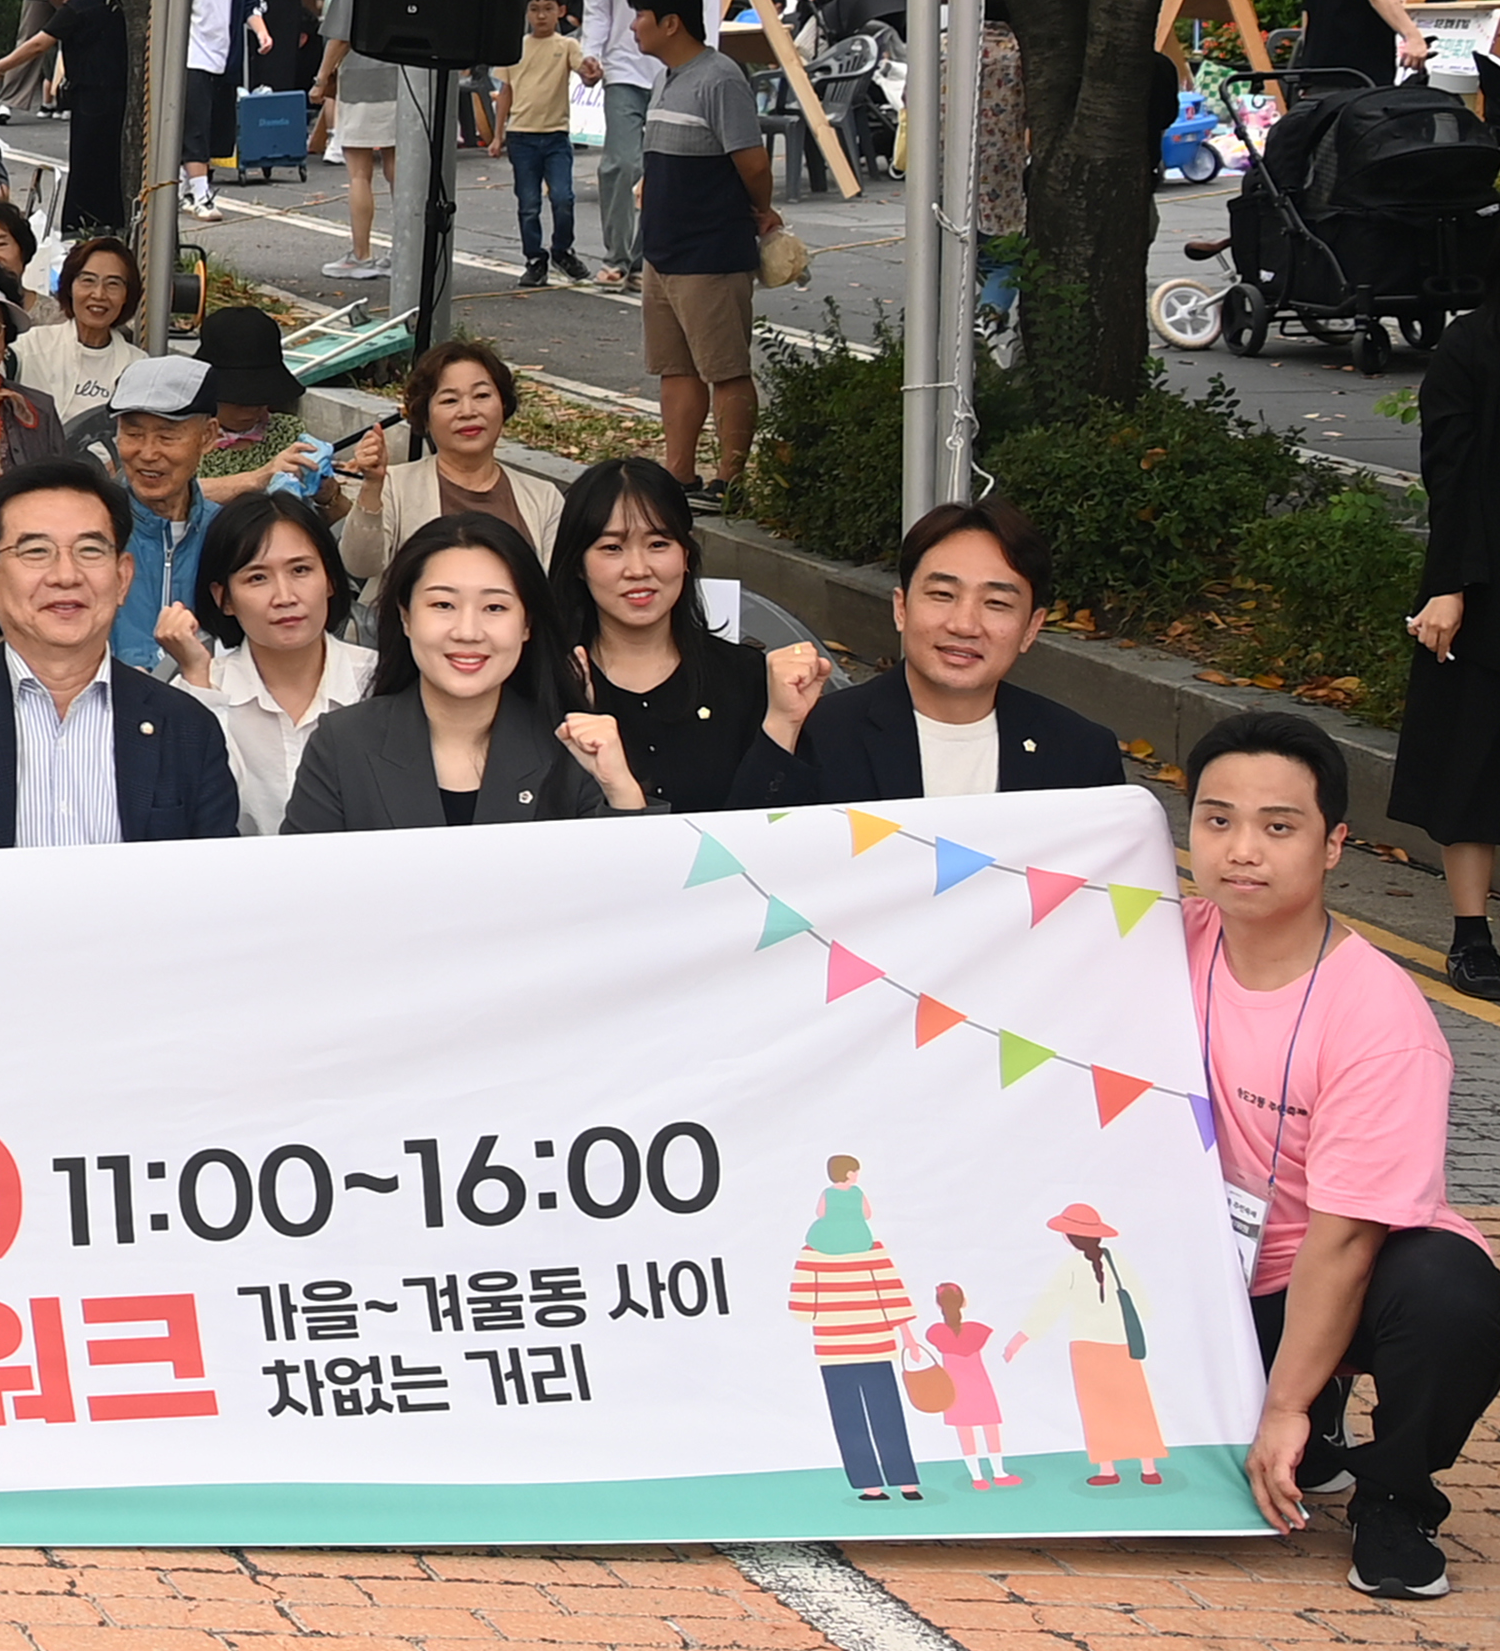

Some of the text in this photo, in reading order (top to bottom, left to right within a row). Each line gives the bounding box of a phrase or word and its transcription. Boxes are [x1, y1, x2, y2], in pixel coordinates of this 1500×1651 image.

[52, 1121, 720, 1247] 11:00~16:00
[237, 1257, 730, 1342] 가을~겨울동 사이
[262, 1343, 592, 1418] 차없는 거리
